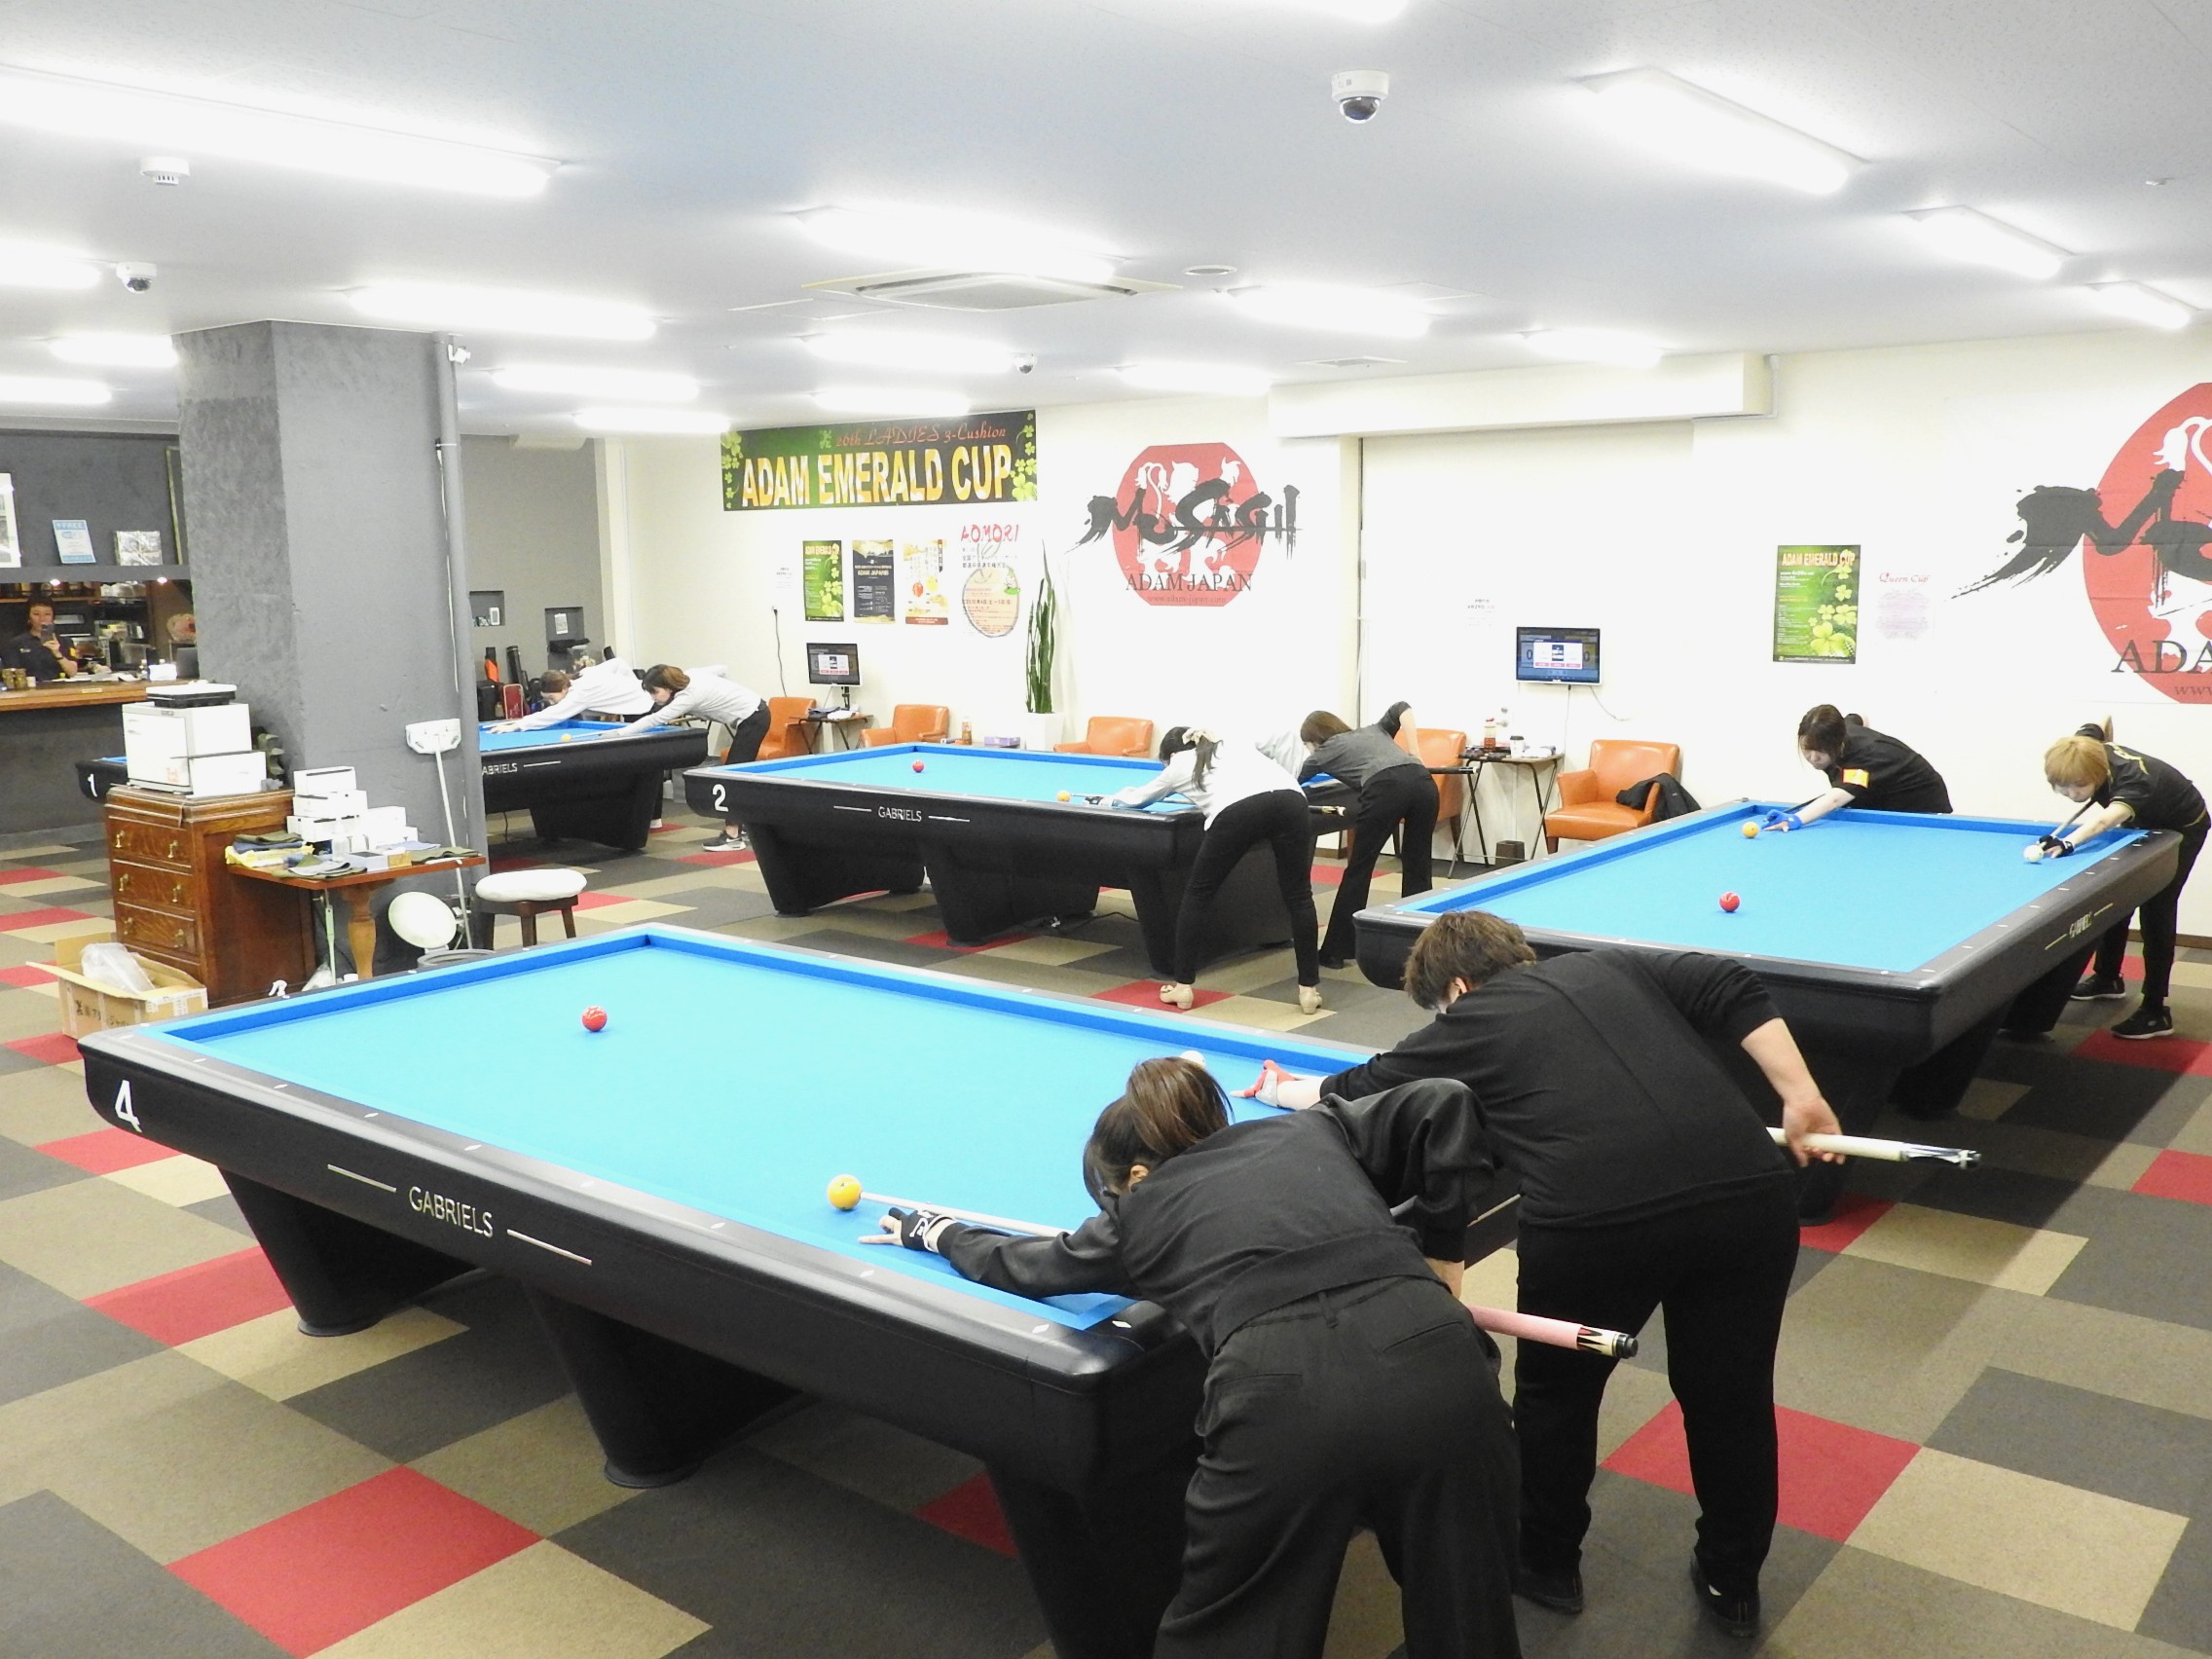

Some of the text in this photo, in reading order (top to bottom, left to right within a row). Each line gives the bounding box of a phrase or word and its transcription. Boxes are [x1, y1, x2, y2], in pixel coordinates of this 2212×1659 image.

[835, 421, 1007, 447] 20th LADIES 3-Cushion
[742, 444, 1012, 507] ADAM EMERALD CUP
[961, 524, 1019, 543] AOMORI
[1782, 553, 1803, 566] ADAM
[1804, 552, 1838, 566] EMERALD
[1126, 573, 1253, 592] ADAM JAPAN
[1879, 571, 1931, 584] Queen Cup
[2111, 640, 2212, 674] ADA
[481, 762, 518, 775] ABRIELS
[88, 773, 97, 797] 1
[712, 783, 729, 812] 2
[878, 806, 922, 823] GABRIELS
[115, 1080, 142, 1132] 4
[409, 1186, 494, 1238] GABRIELS
